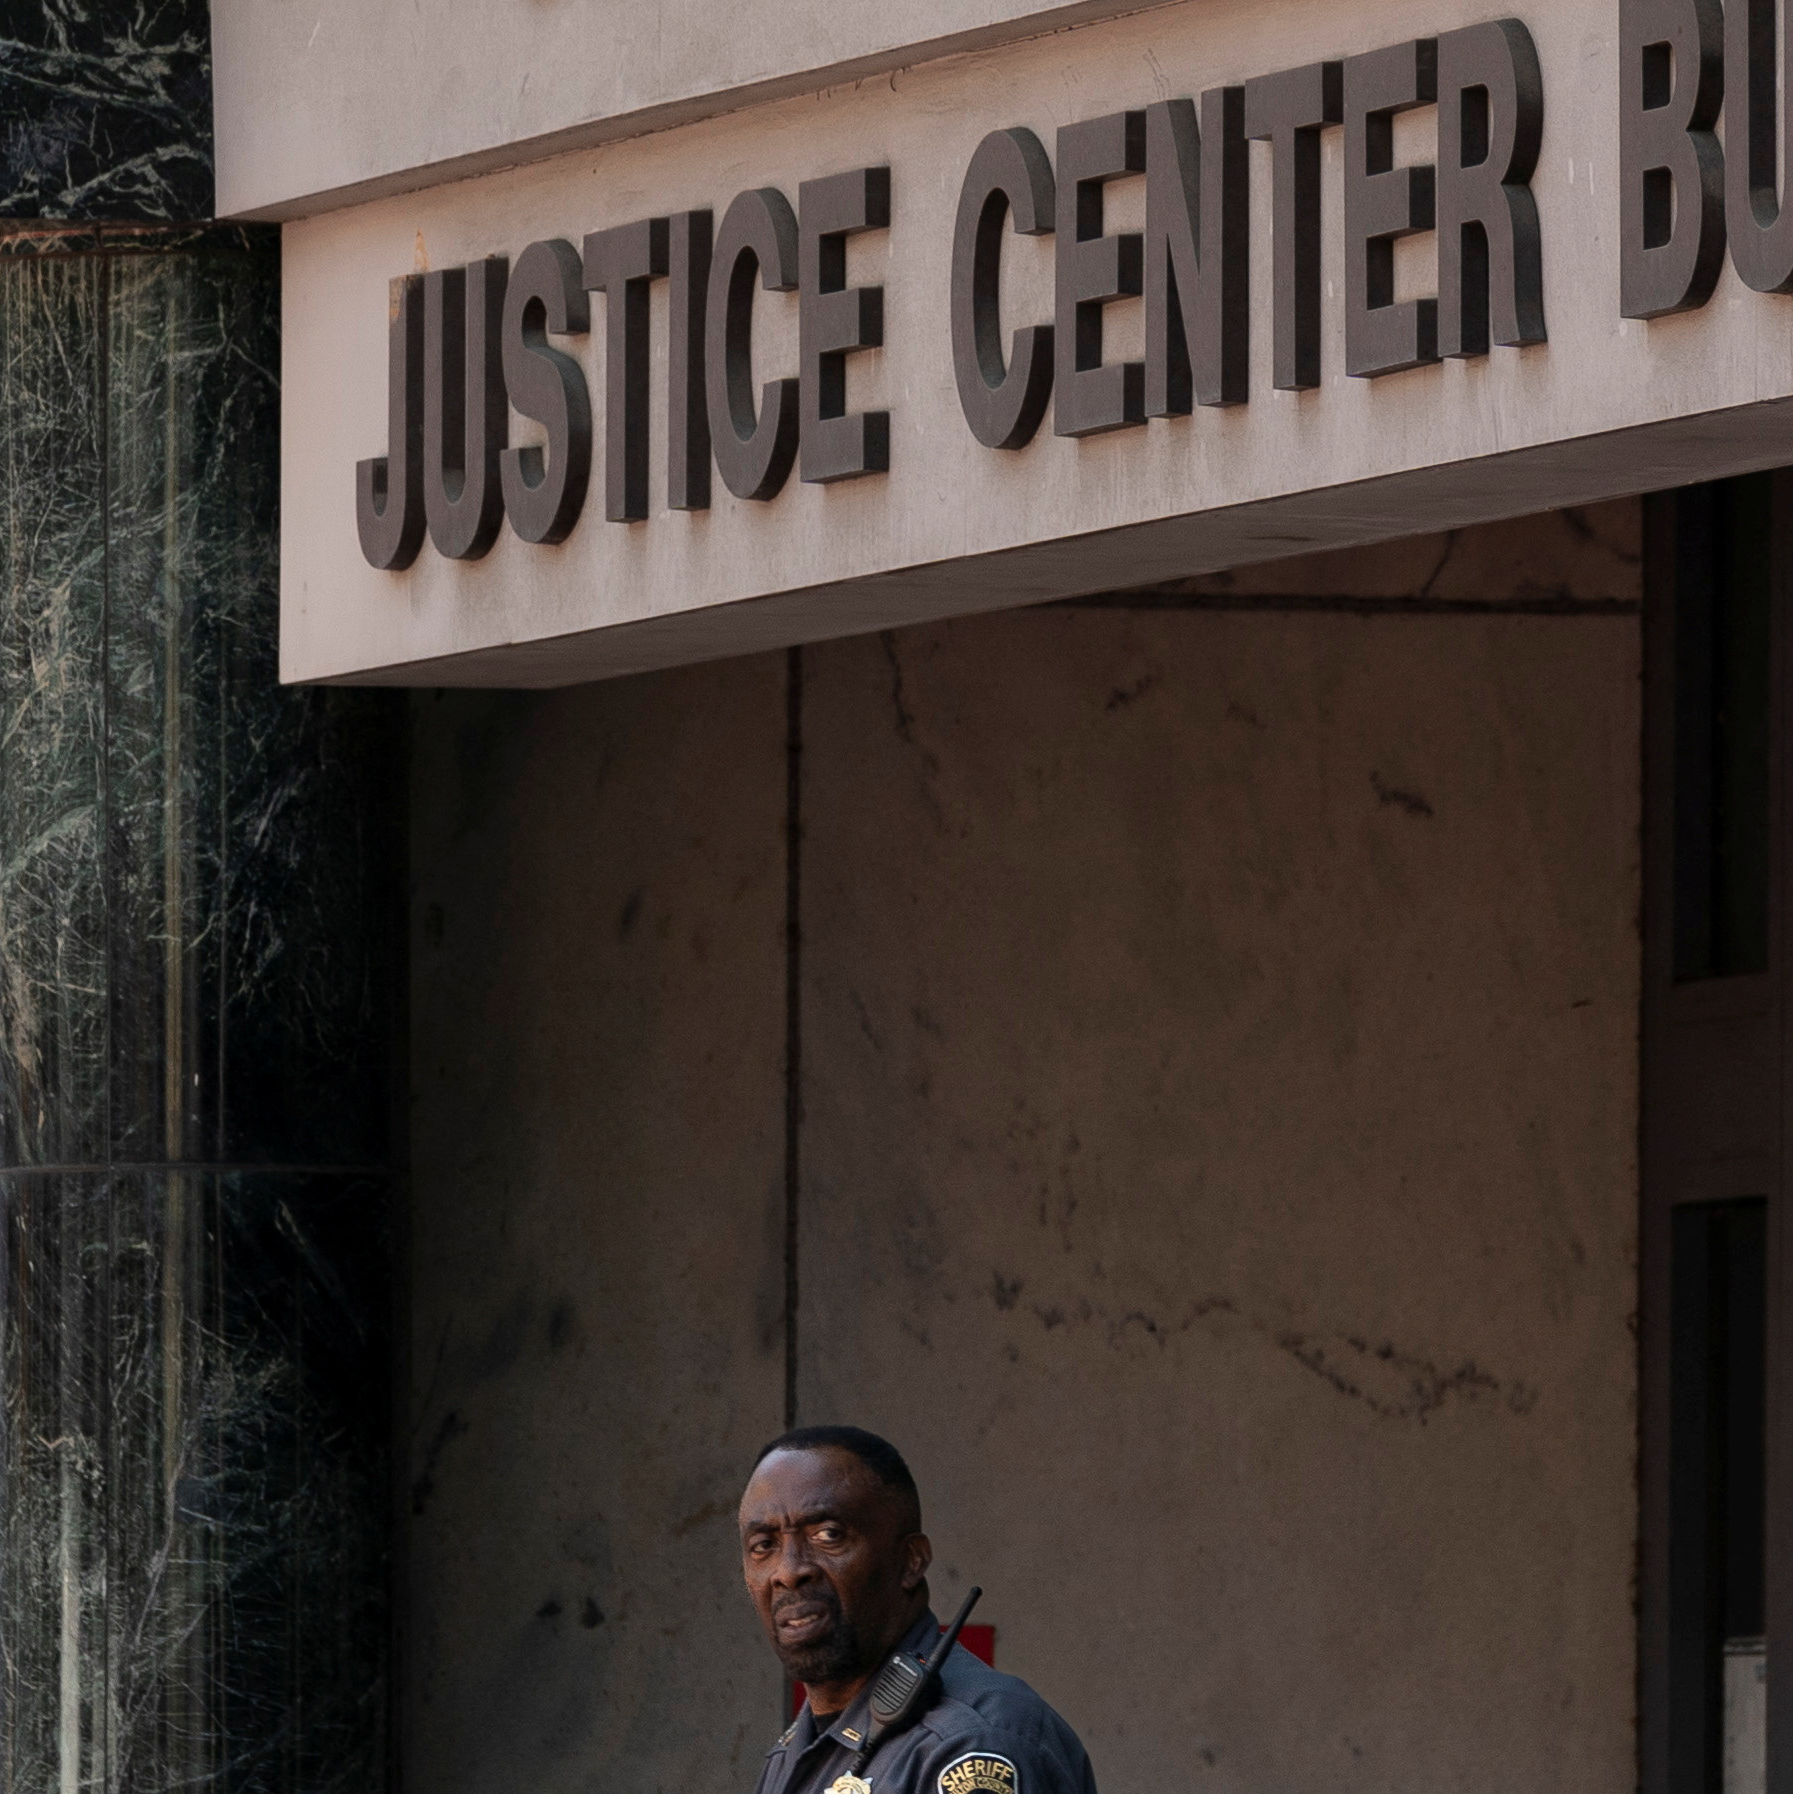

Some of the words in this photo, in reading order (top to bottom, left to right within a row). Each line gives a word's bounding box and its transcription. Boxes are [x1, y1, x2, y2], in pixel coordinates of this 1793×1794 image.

[356, 166, 890, 571] JUSTICE
[951, 17, 1547, 451] CENTER
[942, 1760, 1014, 1791] SHERIFF
